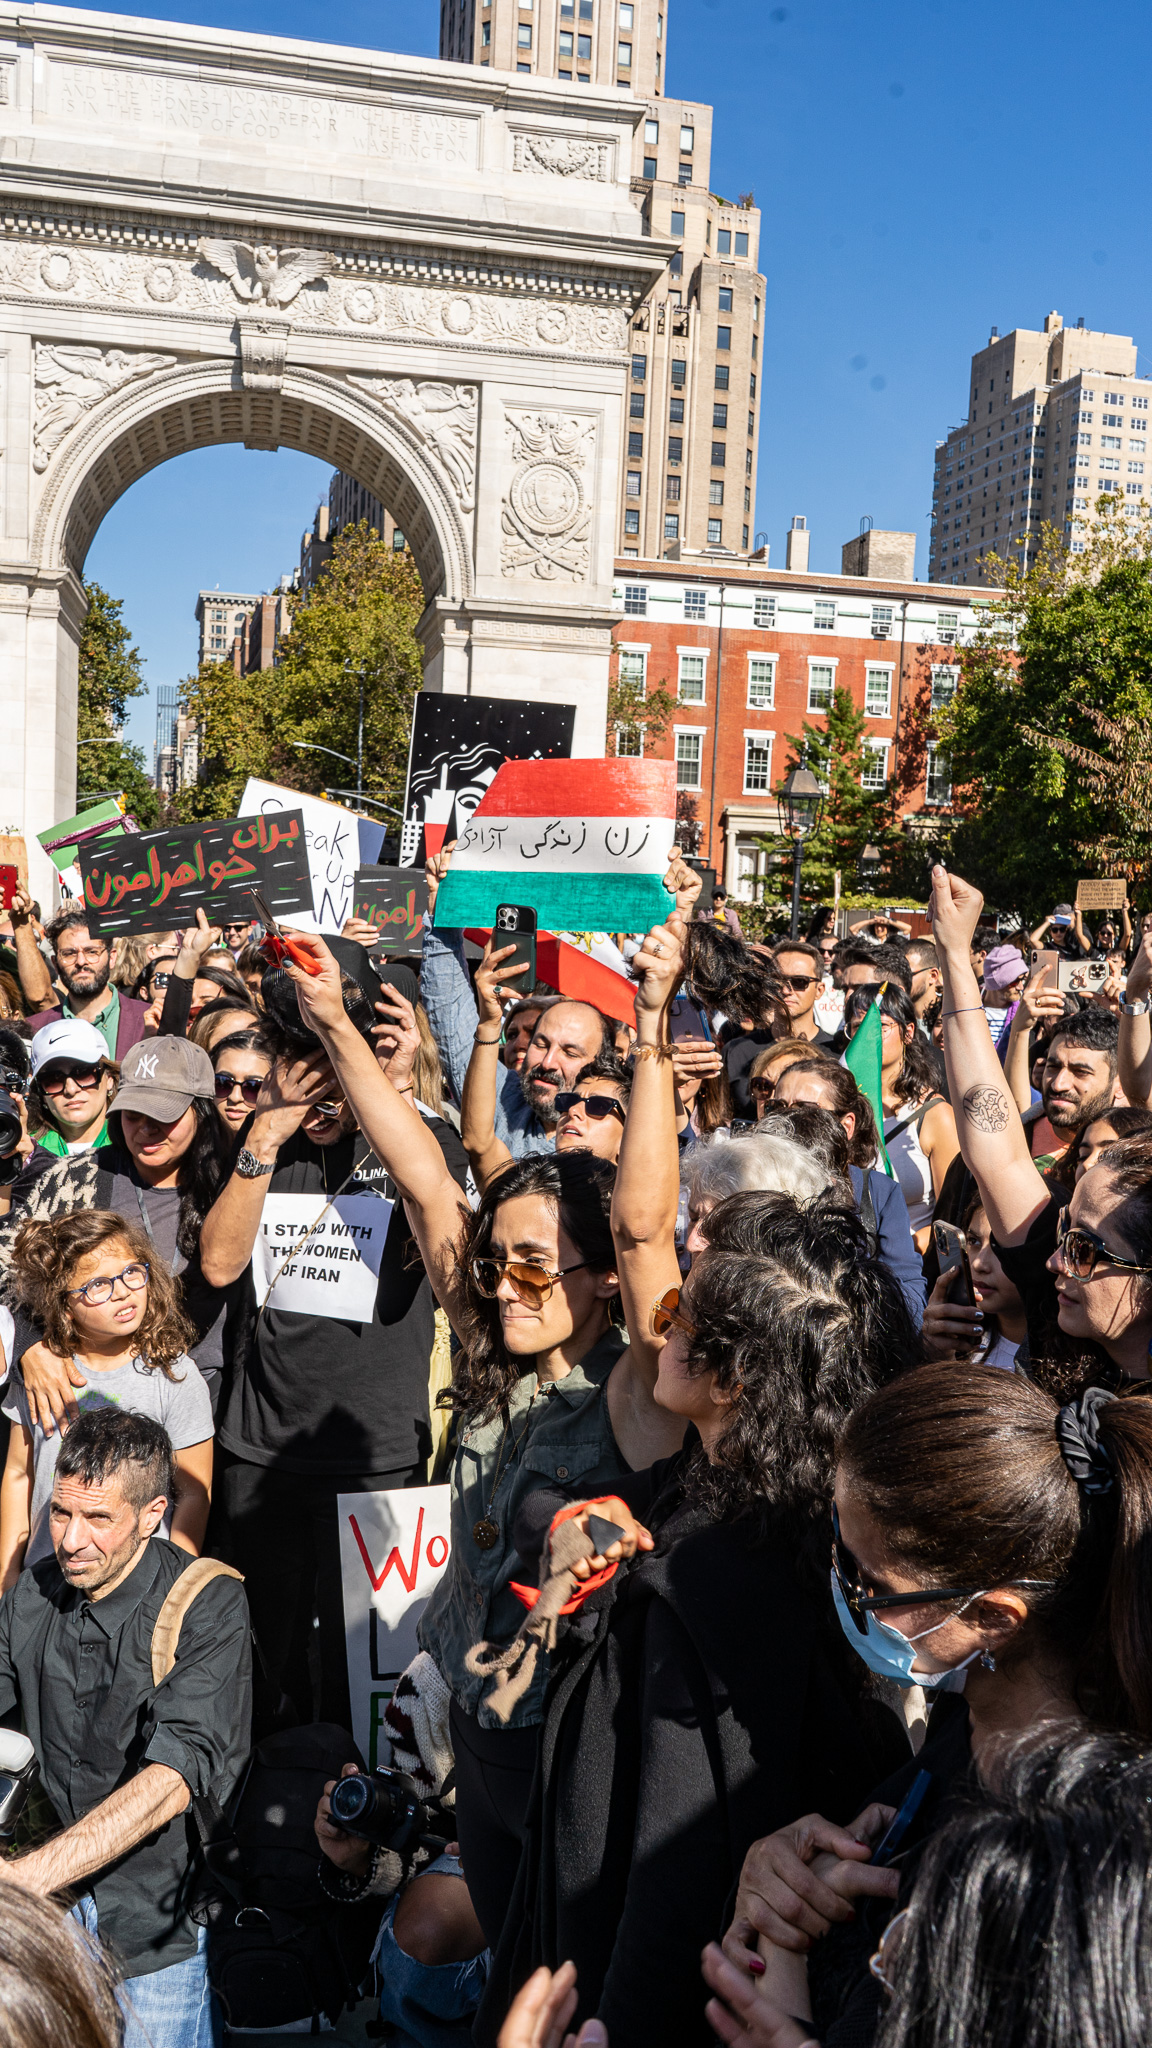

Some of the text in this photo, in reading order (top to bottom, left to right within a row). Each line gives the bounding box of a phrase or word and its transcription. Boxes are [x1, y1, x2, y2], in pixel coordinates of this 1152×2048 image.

[61, 66, 469, 134] LET US RAISE A STANDARD TO WHICH THE WISE
[62, 83, 469, 148] AND THE HONEST CAN REPAIR THE EVENT
[61, 98, 280, 139] IS IN THE HAND OF GOD
[352, 136, 468, 162] WASHINGTON
[232, 815, 300, 854] برای
[519, 820, 587, 859] زندگی
[605, 823, 651, 859] زن
[818, 1003, 845, 1012] GUCC
[353, 1167, 389, 1182] OLINA
[263, 1223, 268, 1236] I
[330, 1223, 373, 1240] WITH
[303, 1243, 362, 1262] WOMEN
[281, 1263, 341, 1283] OF IRAN
[348, 1506, 449, 1593] Wo
[376, 1766, 392, 1776] Canon
